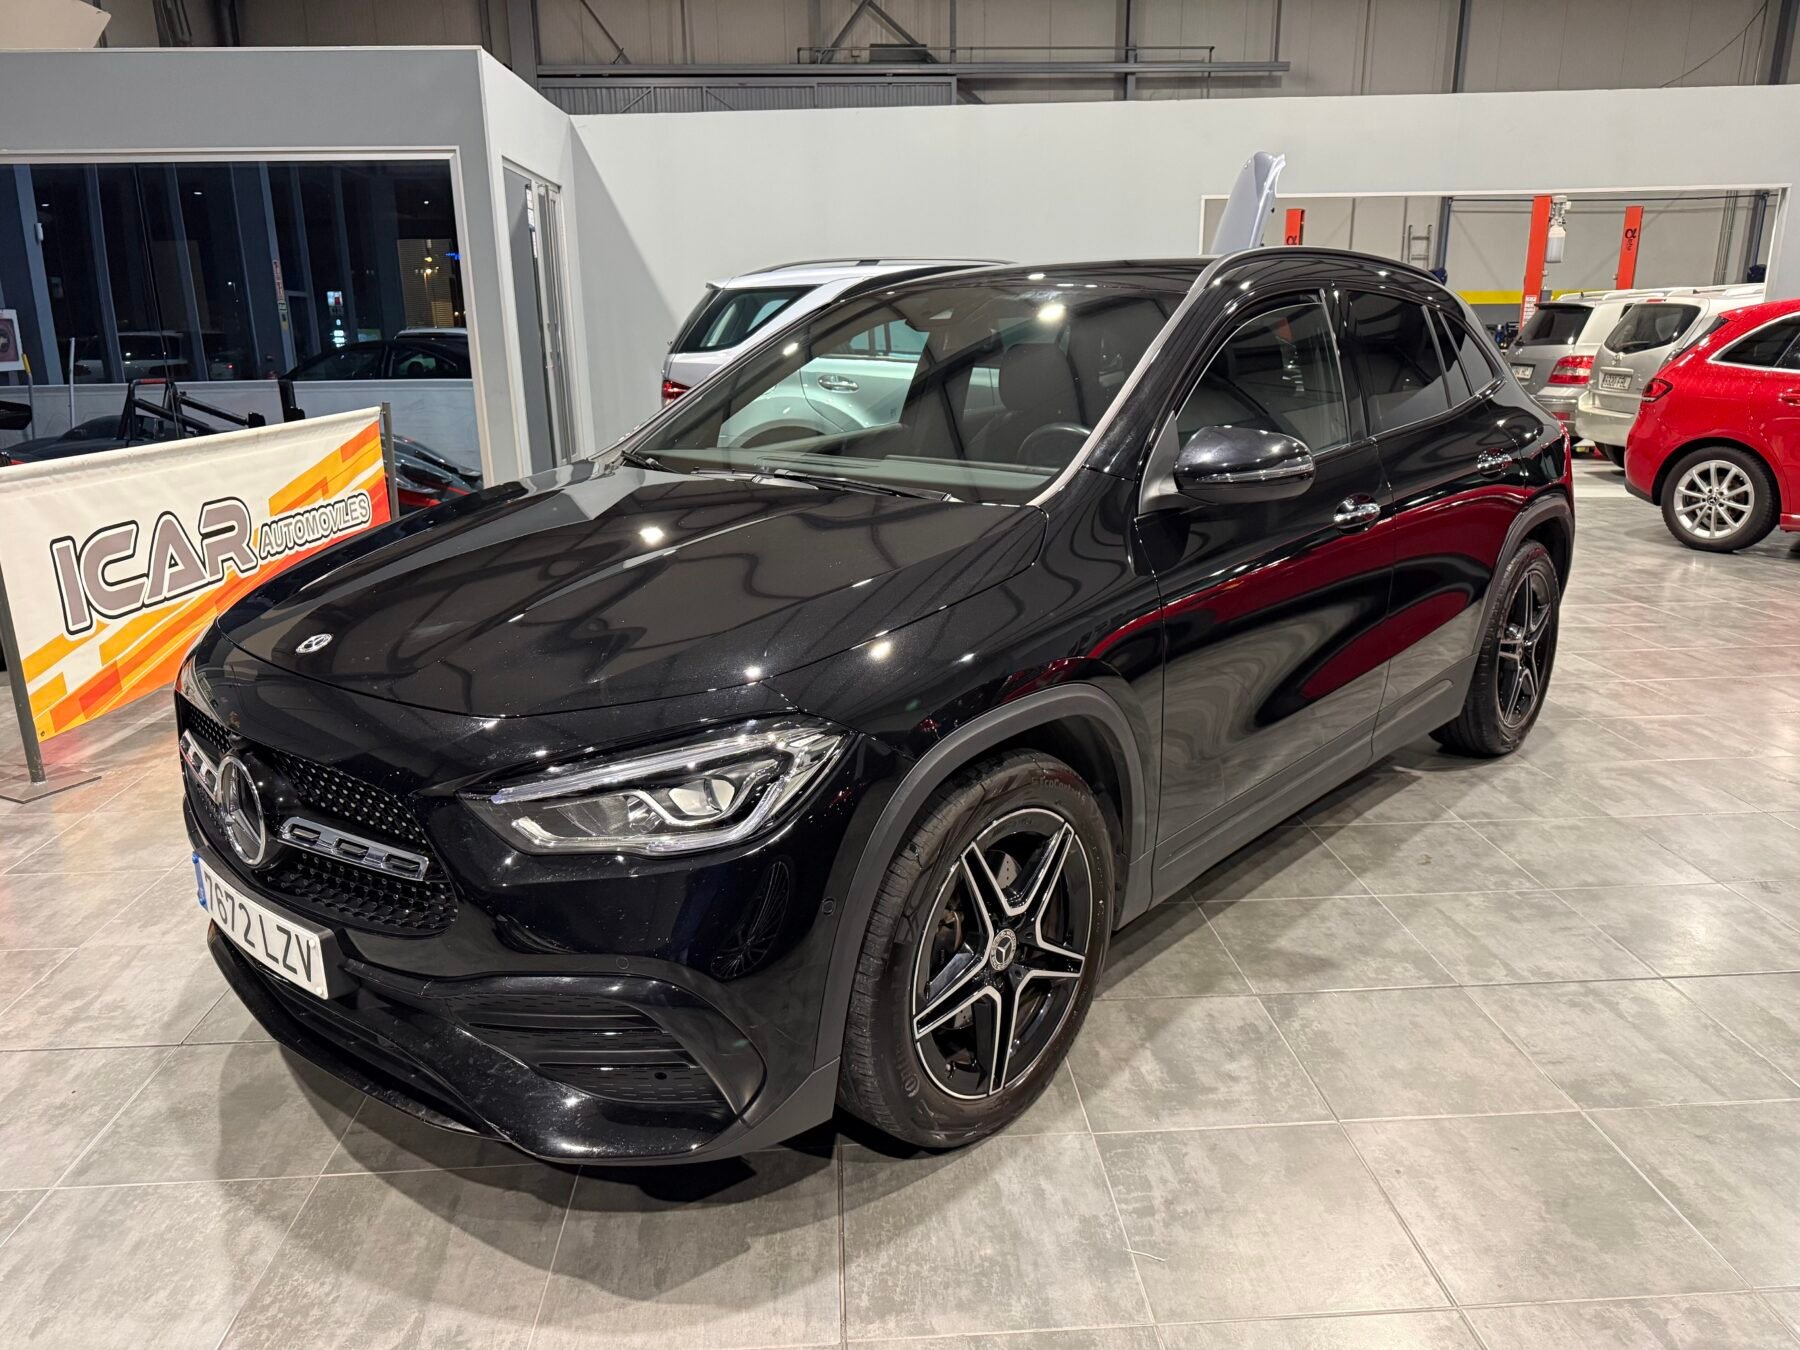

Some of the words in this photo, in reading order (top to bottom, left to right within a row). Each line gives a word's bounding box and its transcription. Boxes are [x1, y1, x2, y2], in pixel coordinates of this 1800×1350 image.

[51, 497, 257, 635] ICAR
[261, 494, 370, 559] AUTOMOVILES
[204, 869, 256, 949] 7672
[258, 913, 312, 983] LZV
